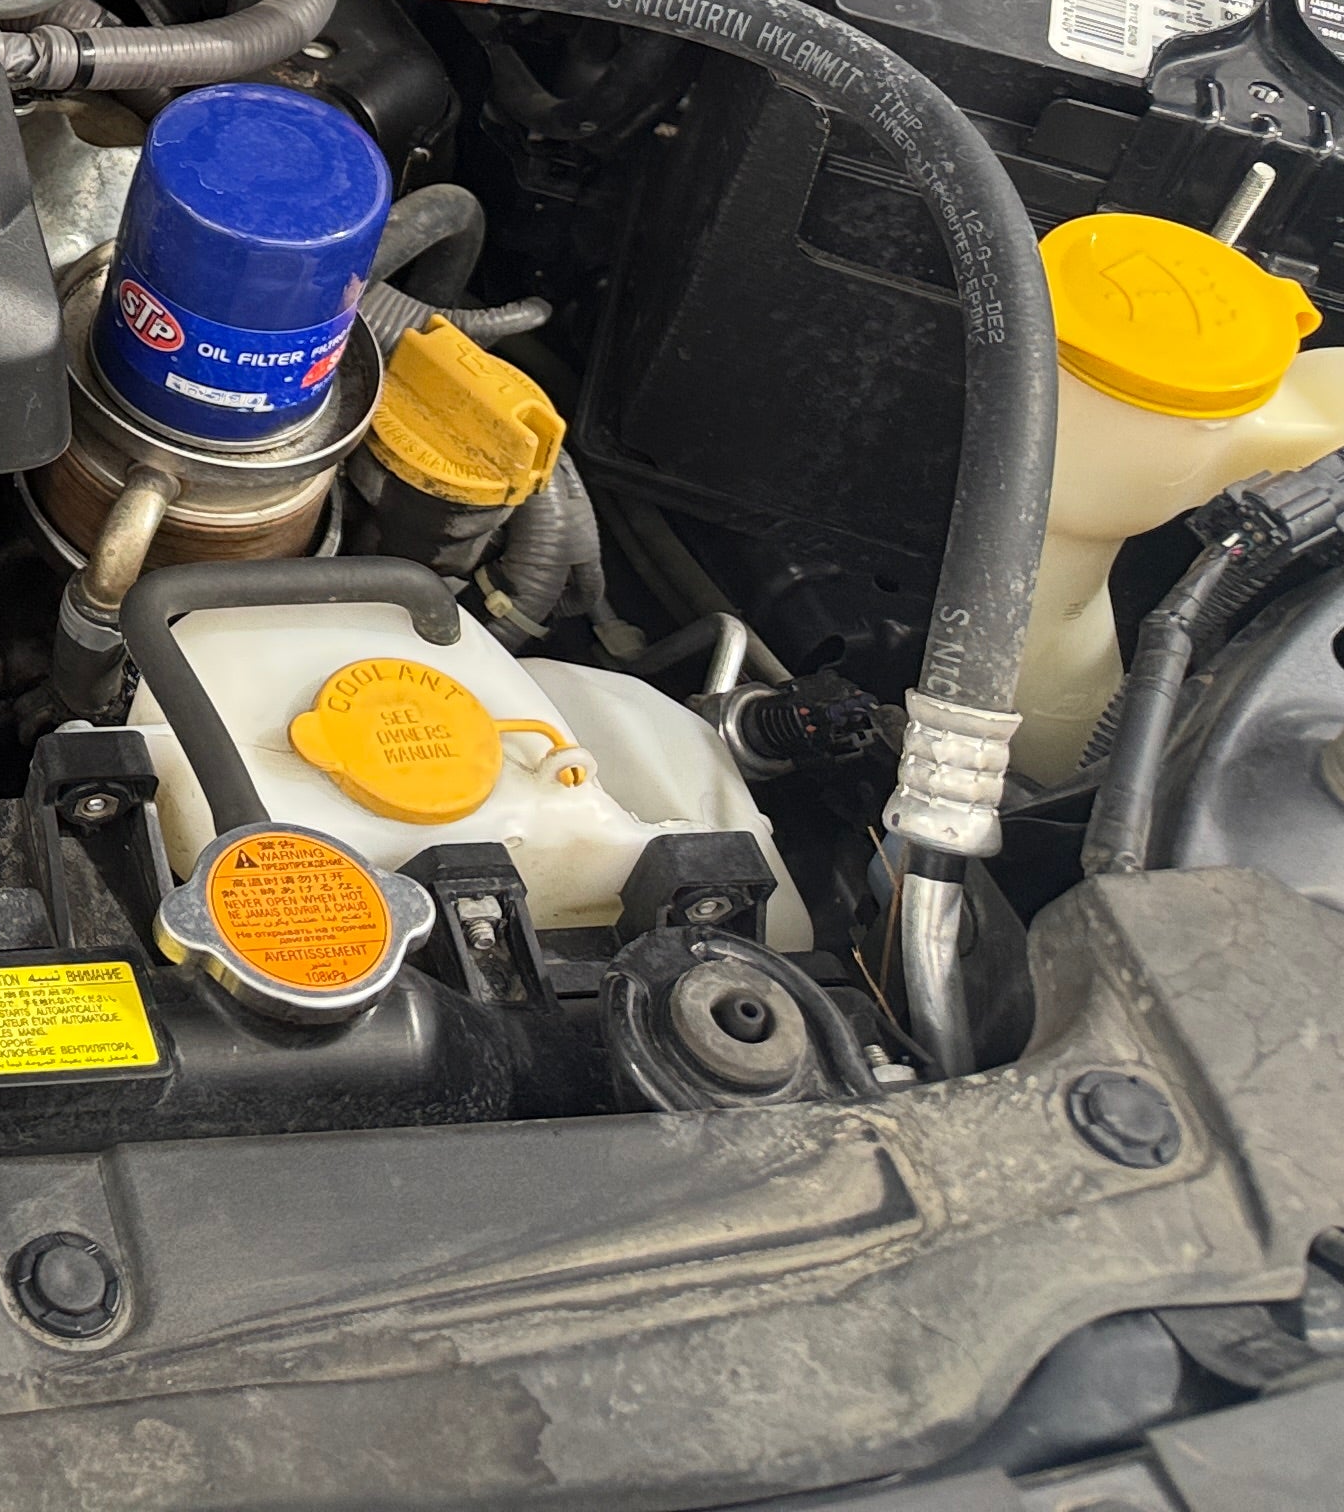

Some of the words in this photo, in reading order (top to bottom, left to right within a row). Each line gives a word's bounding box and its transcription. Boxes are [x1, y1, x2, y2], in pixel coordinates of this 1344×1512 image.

[122, 289, 176, 340] STP
[198, 342, 231, 364] OIL
[237, 350, 305, 367] FILTER
[328, 663, 464, 713] COOLANT
[380, 707, 419, 727] SEE
[384, 743, 460, 764] MANUAL
[257, 848, 325, 862] WARNING
[224, 897, 263, 910] NEVER
[266, 895, 298, 908] OPEN
[301, 893, 337, 905] WHEN
[228, 909, 243, 921] NE
[245, 907, 281, 920] JAMAIS
[283, 904, 322, 917] OUVRIR
[264, 944, 368, 963] AVERTISSEMENT
[66, 967, 125, 982] ВНИМАНИЕ
[305, 969, 348, 984] 108kPa
